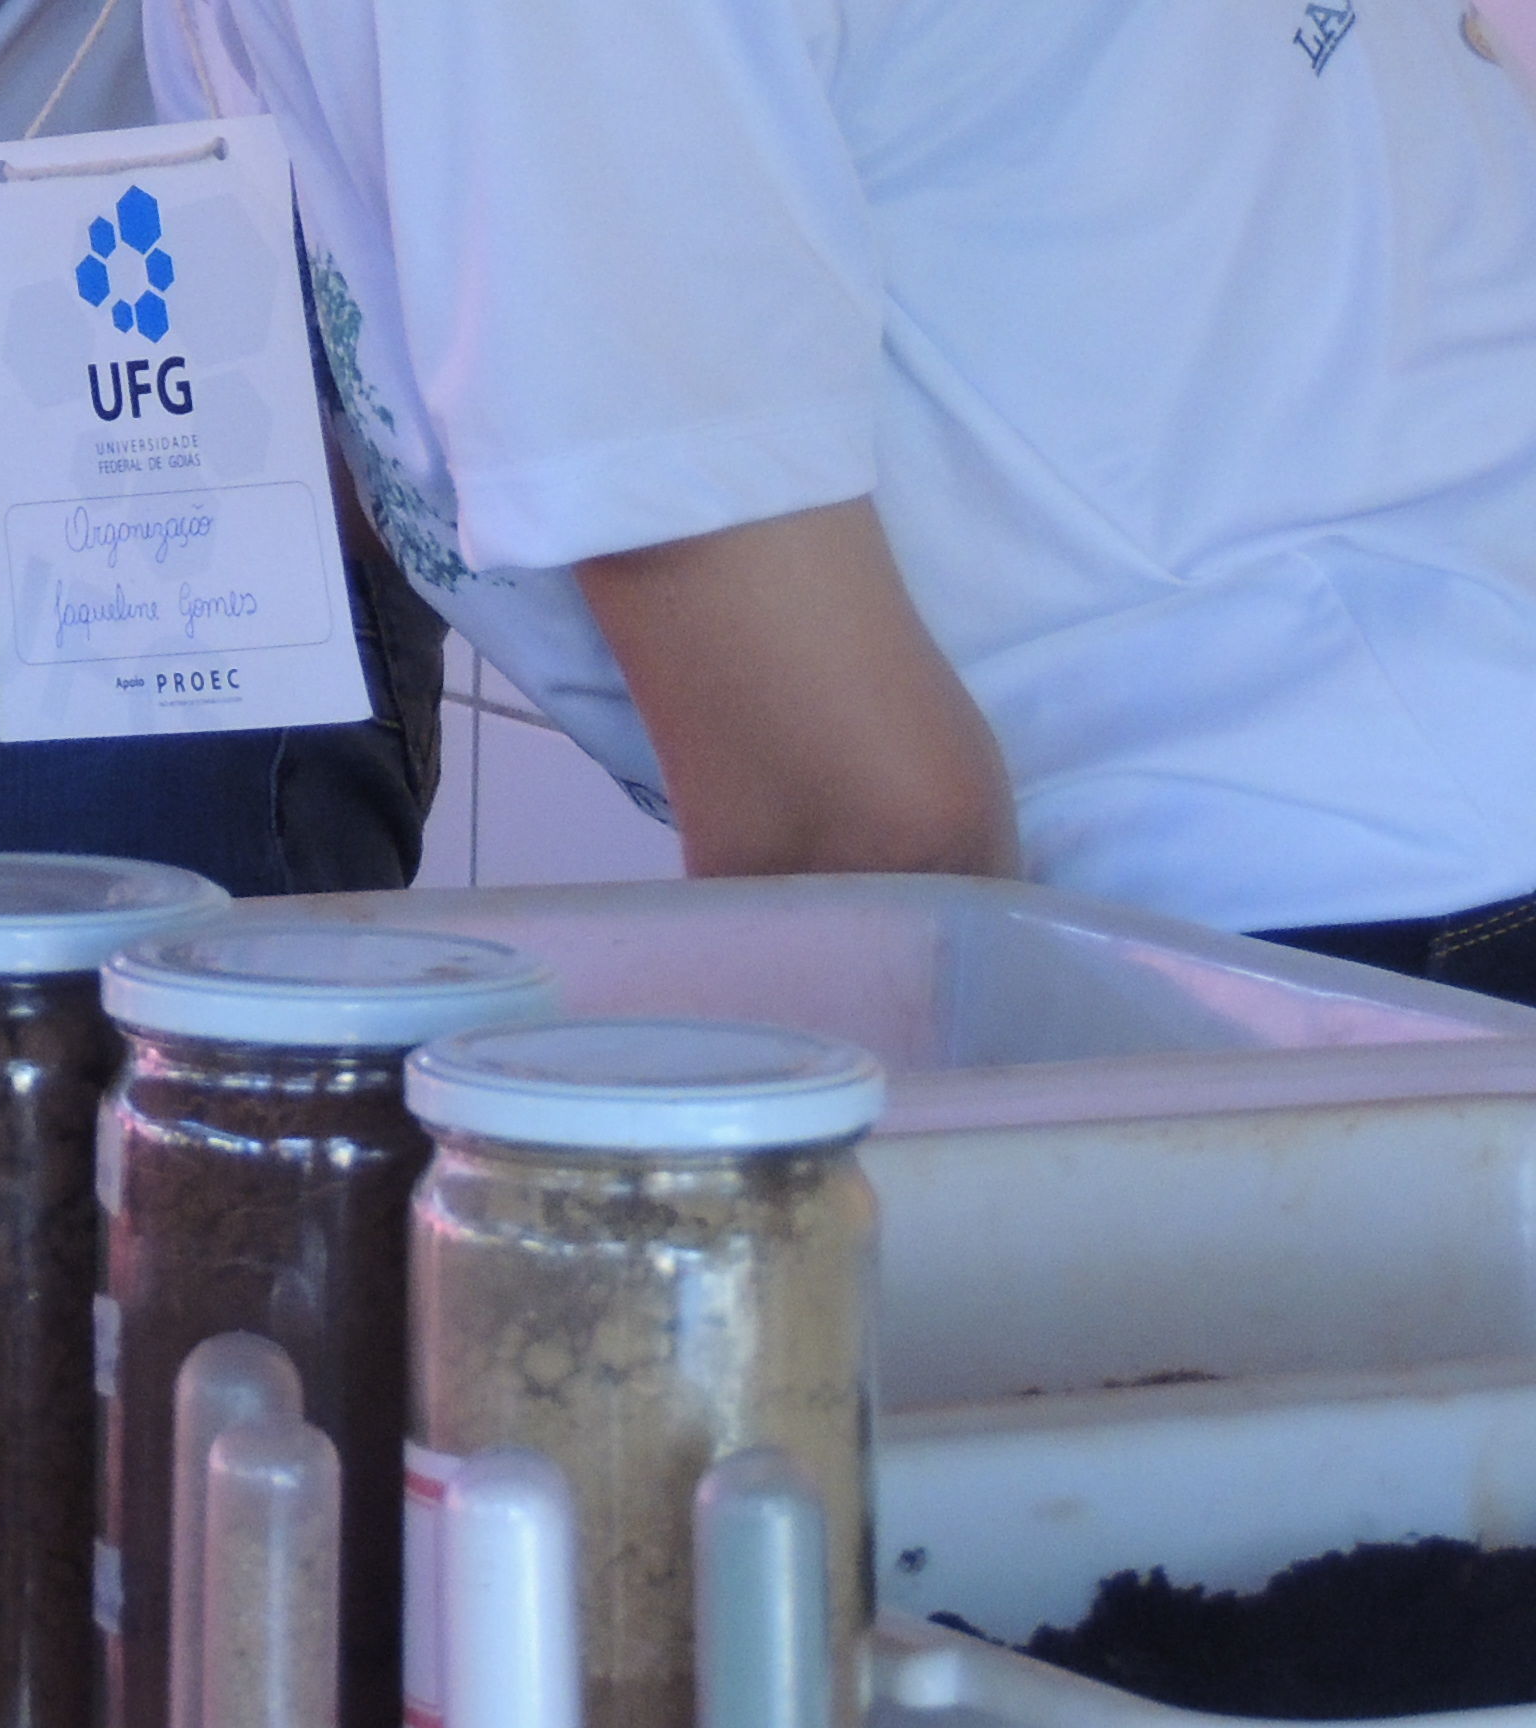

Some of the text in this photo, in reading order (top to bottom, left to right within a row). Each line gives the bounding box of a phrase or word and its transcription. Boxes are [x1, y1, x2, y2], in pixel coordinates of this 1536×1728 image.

[87, 356, 194, 422] UFG
[95, 434, 200, 456] UNIVERSIDADE
[98, 458, 142, 474] FEDERAL
[148, 456, 163, 471] DE
[65, 503, 214, 569] Organização
[54, 578, 258, 649] Jaqueline Gomes
[115, 668, 241, 694] Apoio PROEC
